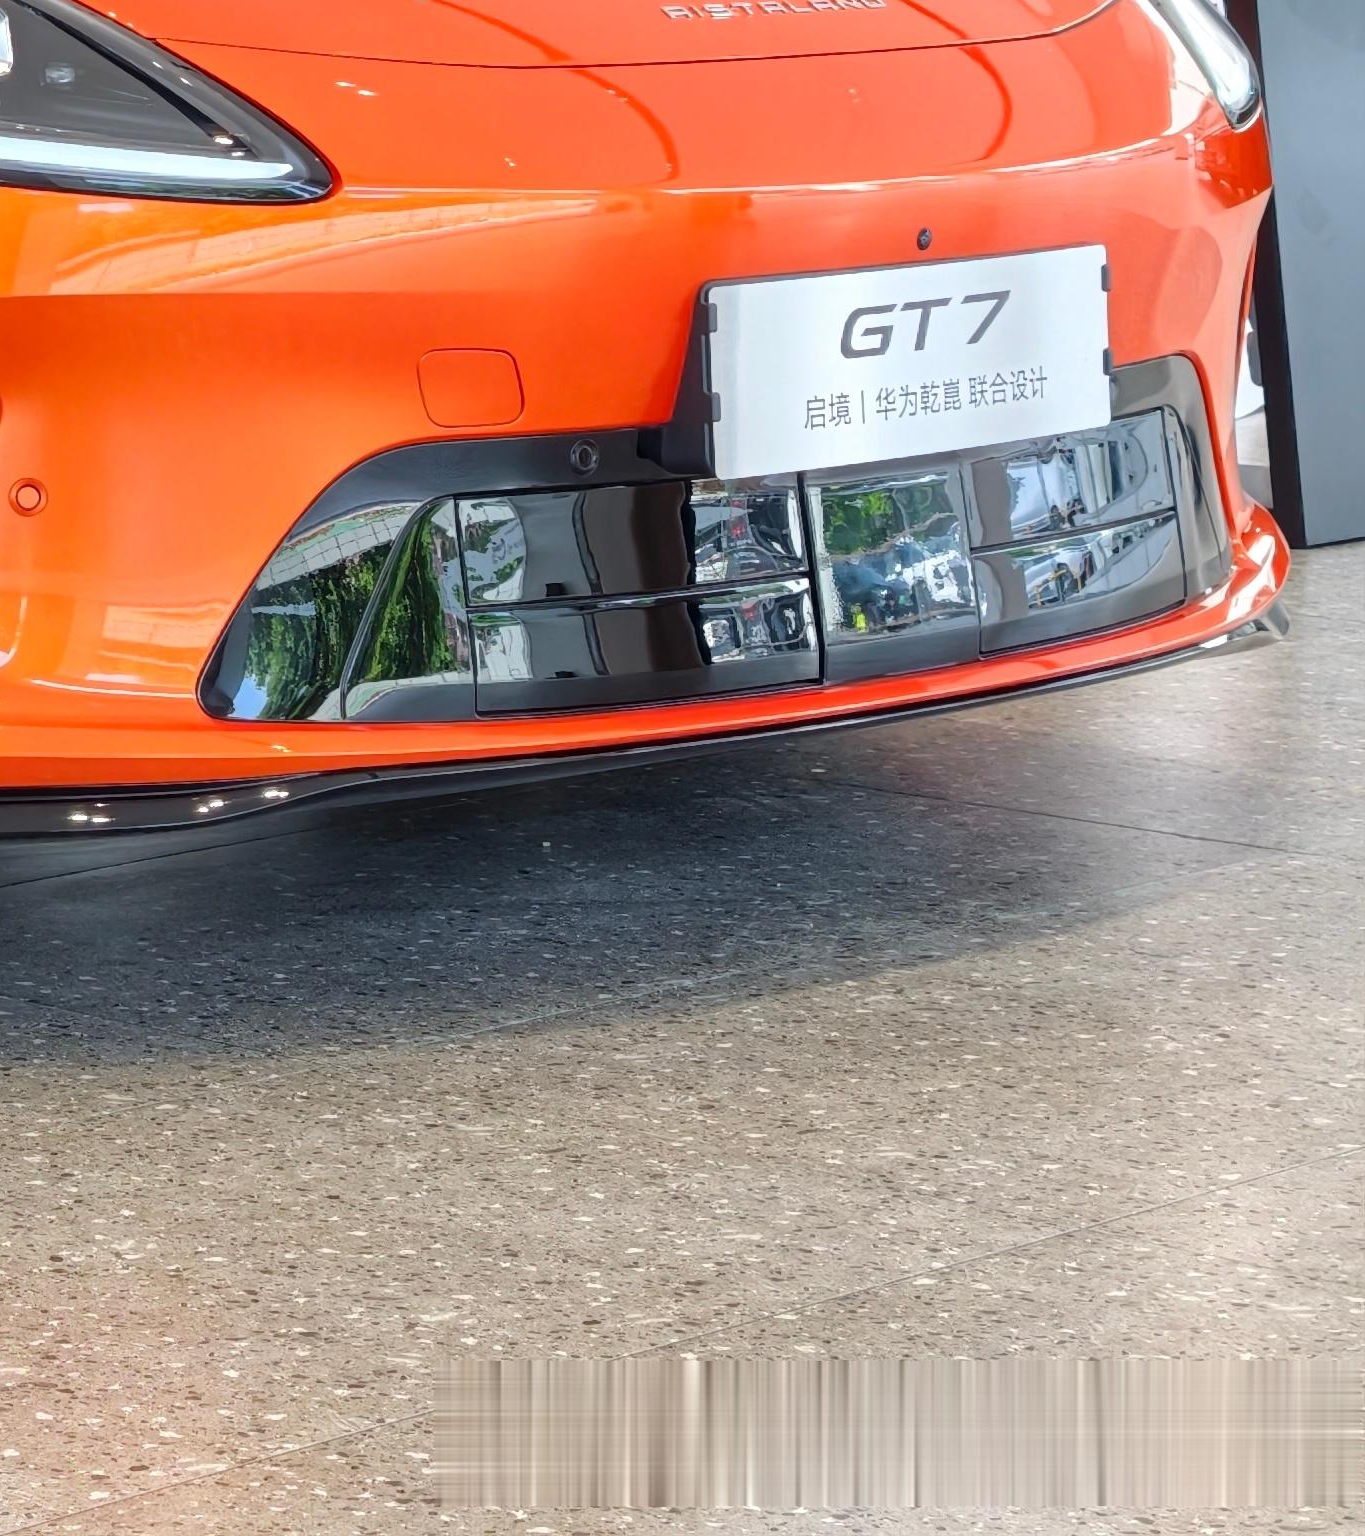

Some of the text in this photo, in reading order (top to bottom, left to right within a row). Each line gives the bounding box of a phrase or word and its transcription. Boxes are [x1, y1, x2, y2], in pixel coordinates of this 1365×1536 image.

[804, 392, 851, 430] 启境
[875, 378, 962, 420] 华为乾崑
[968, 365, 1048, 408] 联合设计
